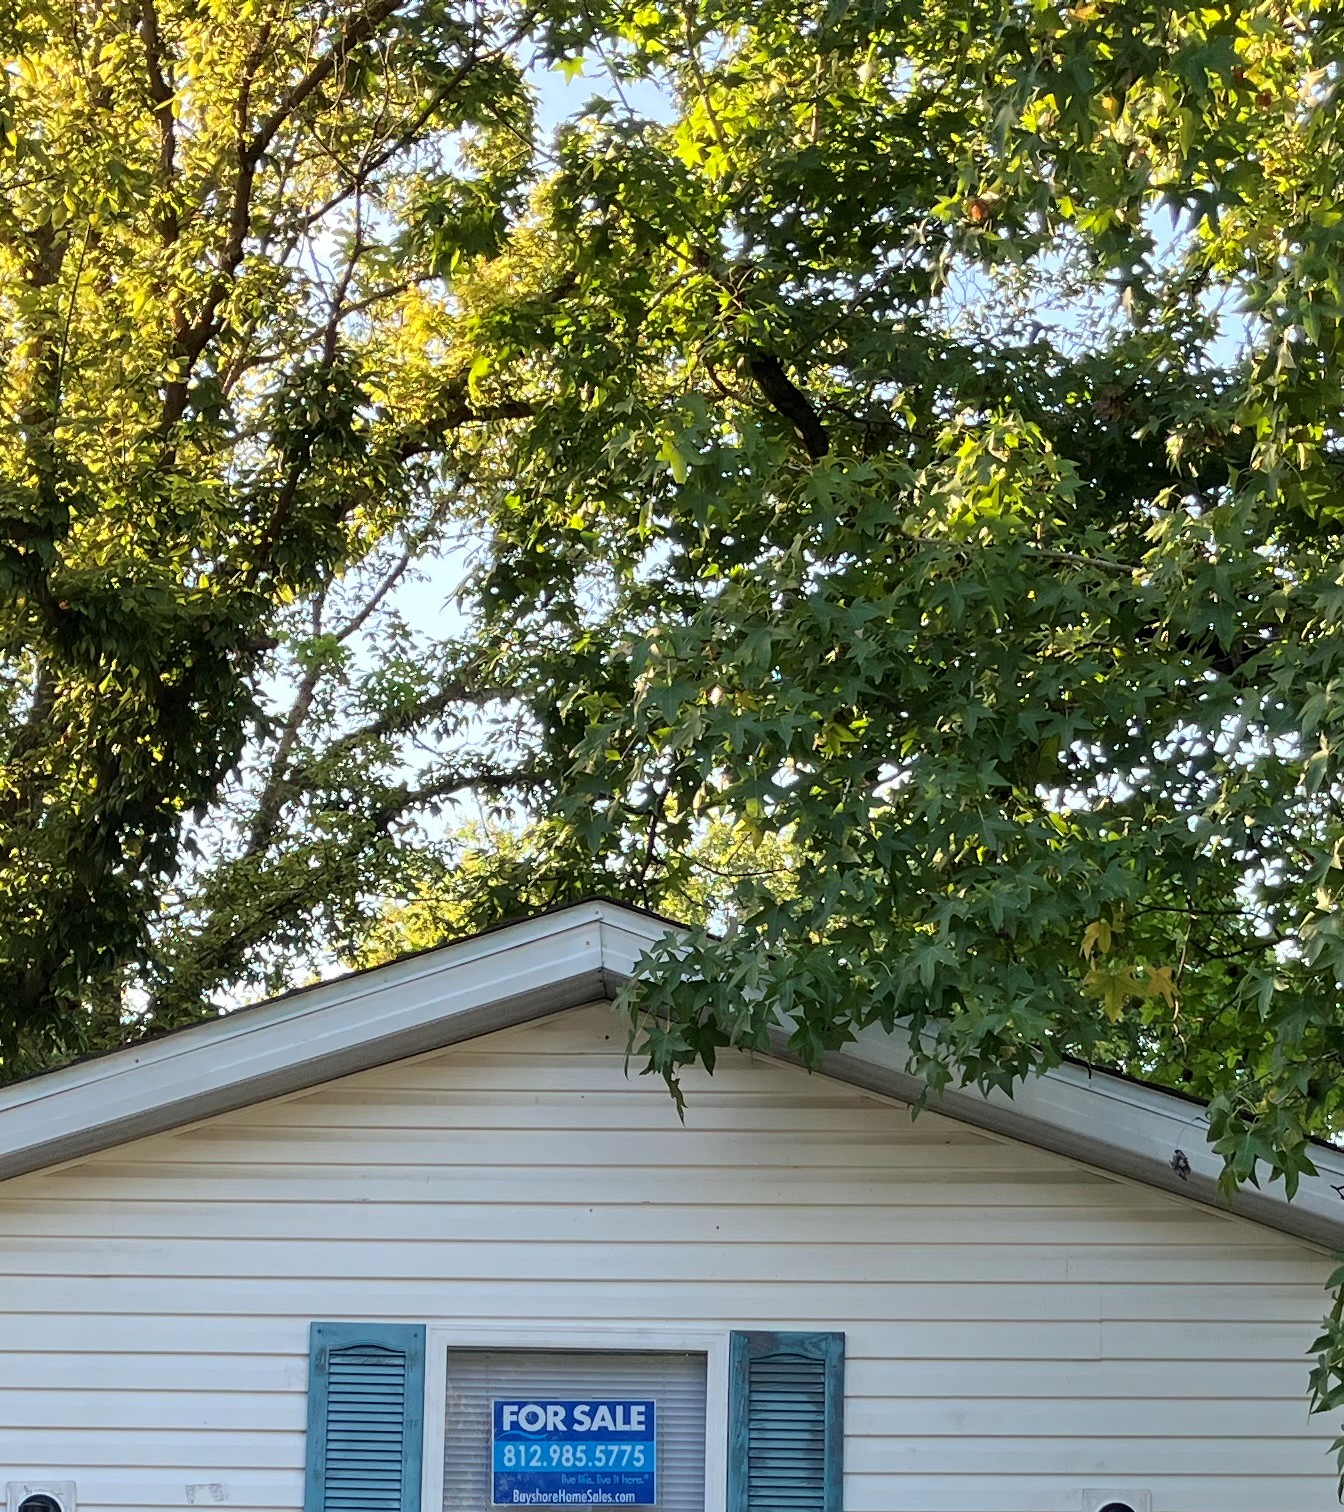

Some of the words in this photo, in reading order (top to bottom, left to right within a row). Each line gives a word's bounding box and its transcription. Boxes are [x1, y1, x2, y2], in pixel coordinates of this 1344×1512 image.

[502, 1404, 567, 1432] FOR
[572, 1404, 646, 1432] SALE
[503, 1445, 645, 1468] 812.985.5775
[513, 1488, 636, 1504] BayshoreHomeSales.com
